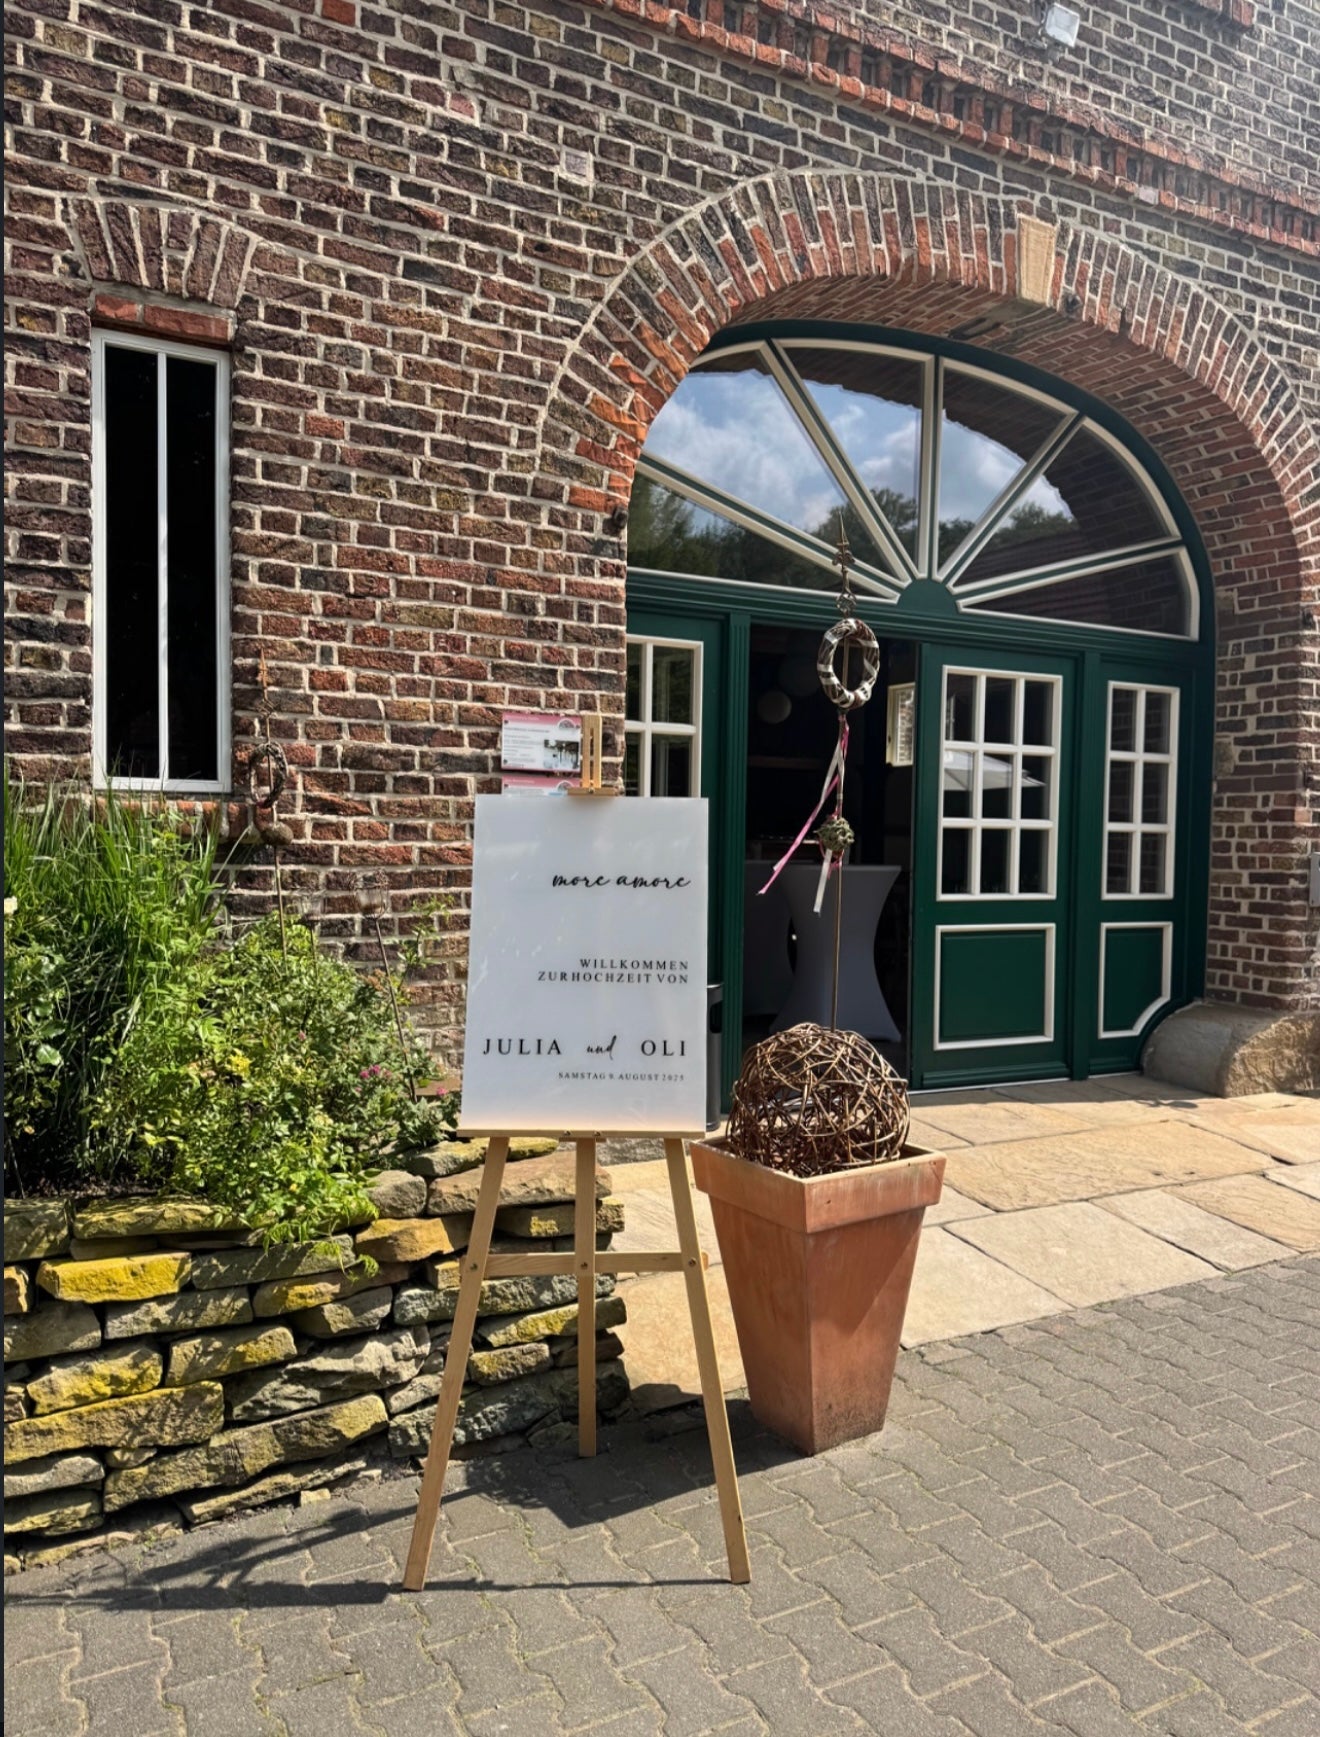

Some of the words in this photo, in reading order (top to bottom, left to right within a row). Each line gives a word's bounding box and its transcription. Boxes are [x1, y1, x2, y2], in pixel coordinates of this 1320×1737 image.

[552, 874, 612, 889] more
[615, 874, 692, 890] amore
[579, 958, 689, 971] WILLKOMMEN
[537, 970, 569, 982] ZUR
[571, 971, 652, 984] HOCHZEIT
[656, 972, 689, 985] VON
[482, 1037, 563, 1056] JULIA
[585, 1034, 618, 1061] und
[640, 1038, 687, 1057] OLI
[558, 1071, 606, 1080] SAMSTAG
[617, 1072, 660, 1081] AUGUST
